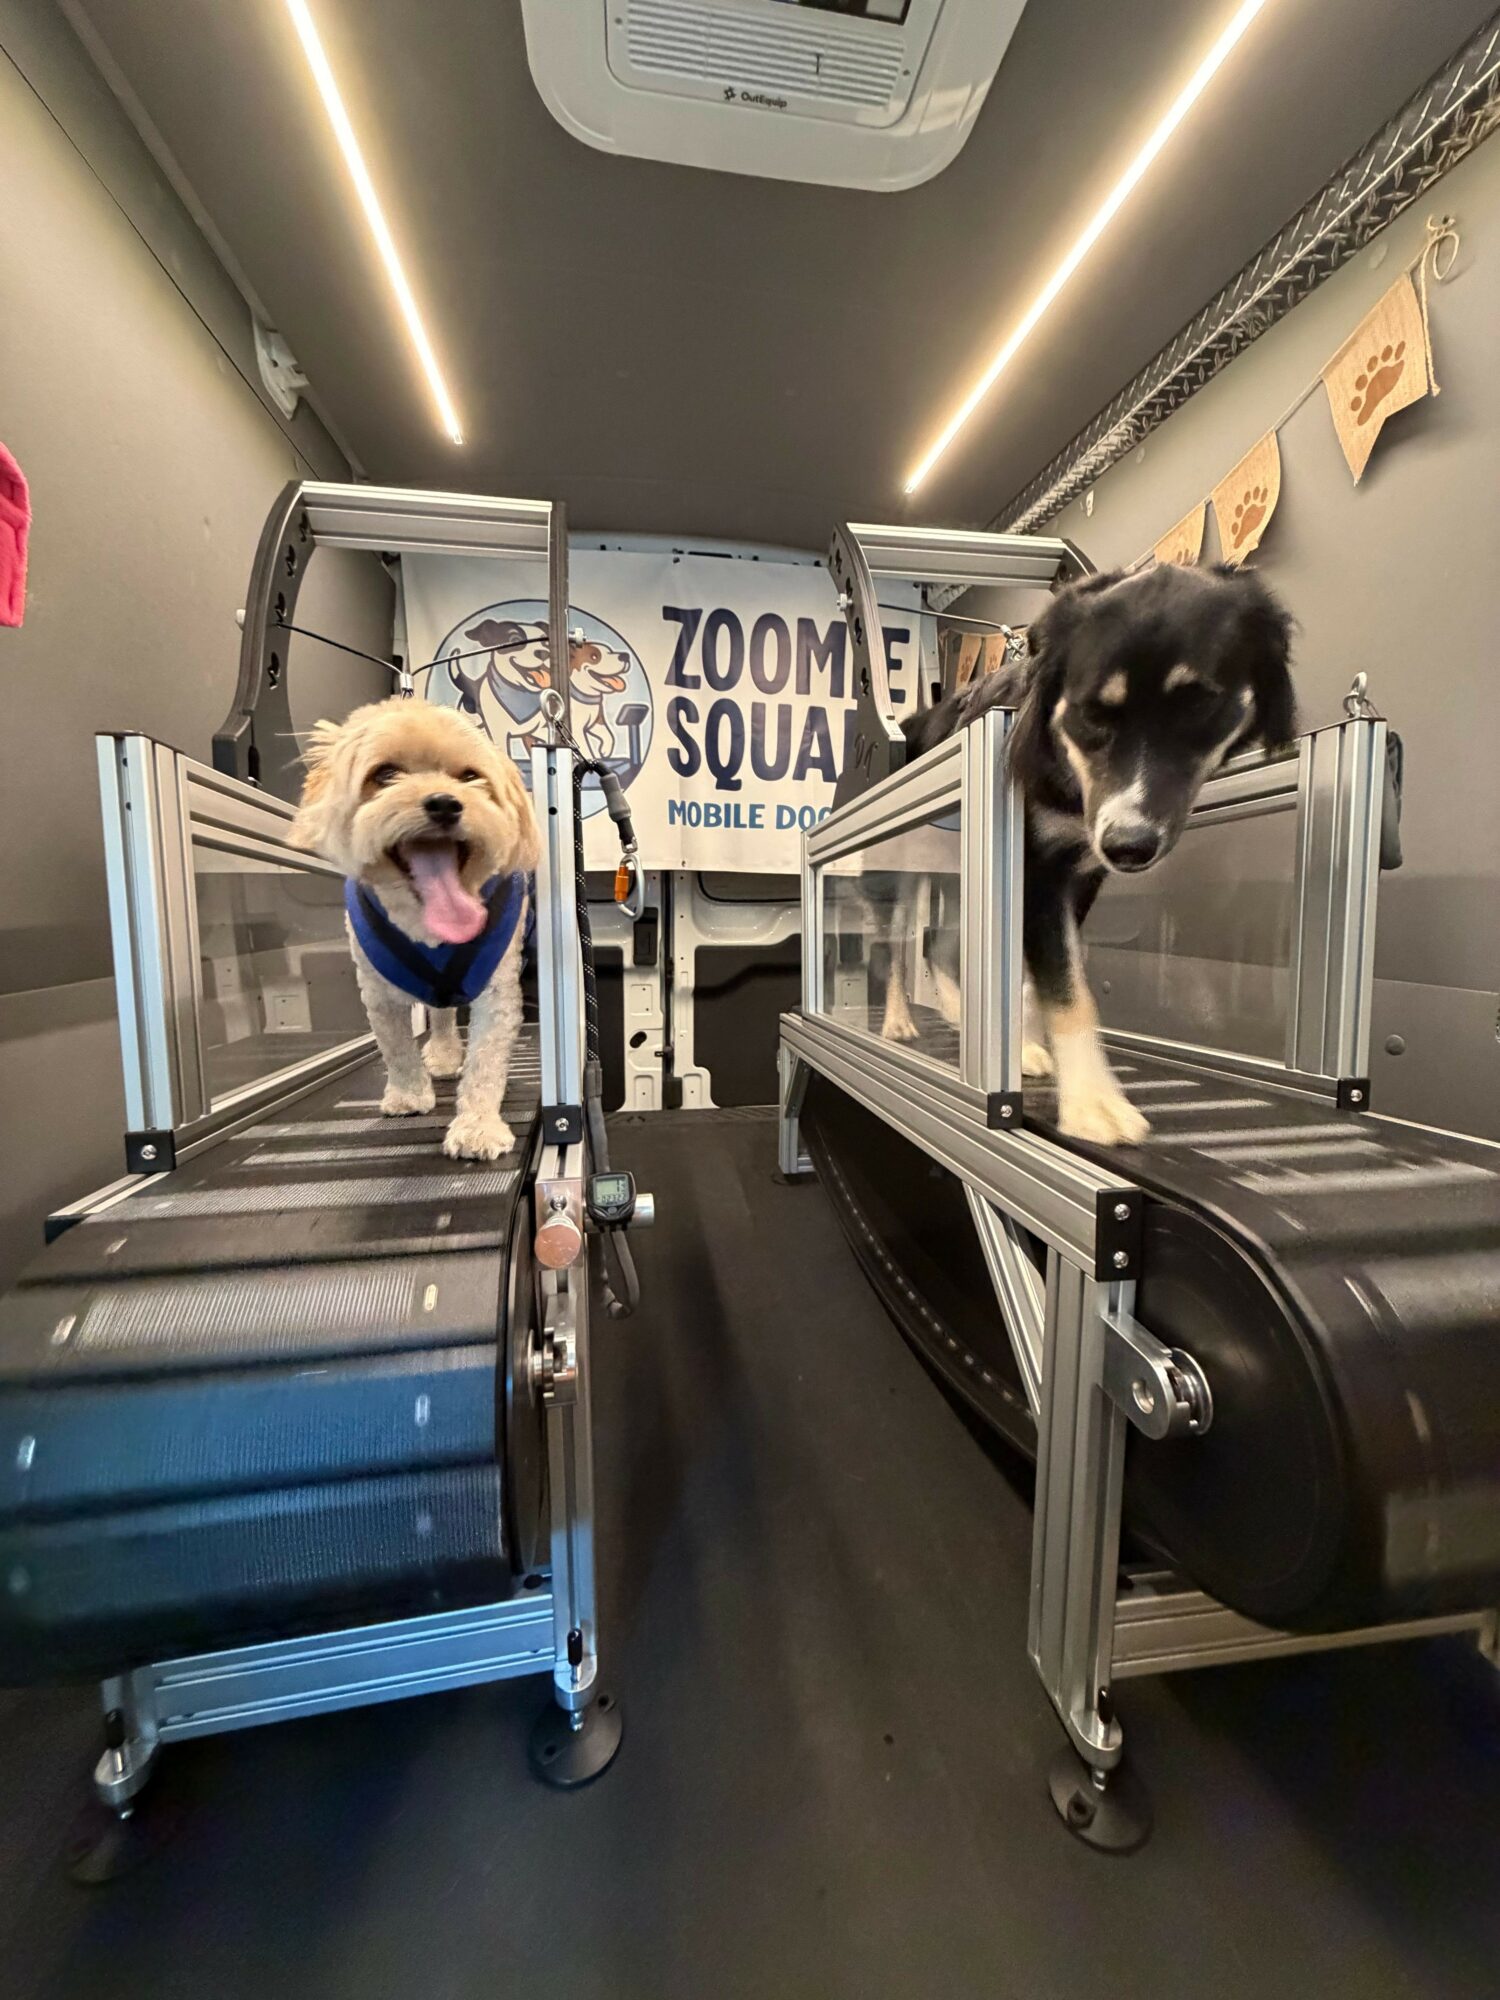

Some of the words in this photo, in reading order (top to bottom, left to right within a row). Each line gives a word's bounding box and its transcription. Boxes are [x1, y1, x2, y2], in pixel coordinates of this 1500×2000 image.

[741, 91, 788, 108] OutEquip
[662, 605, 910, 704] ZOOME
[668, 800, 765, 829] MOBILE
